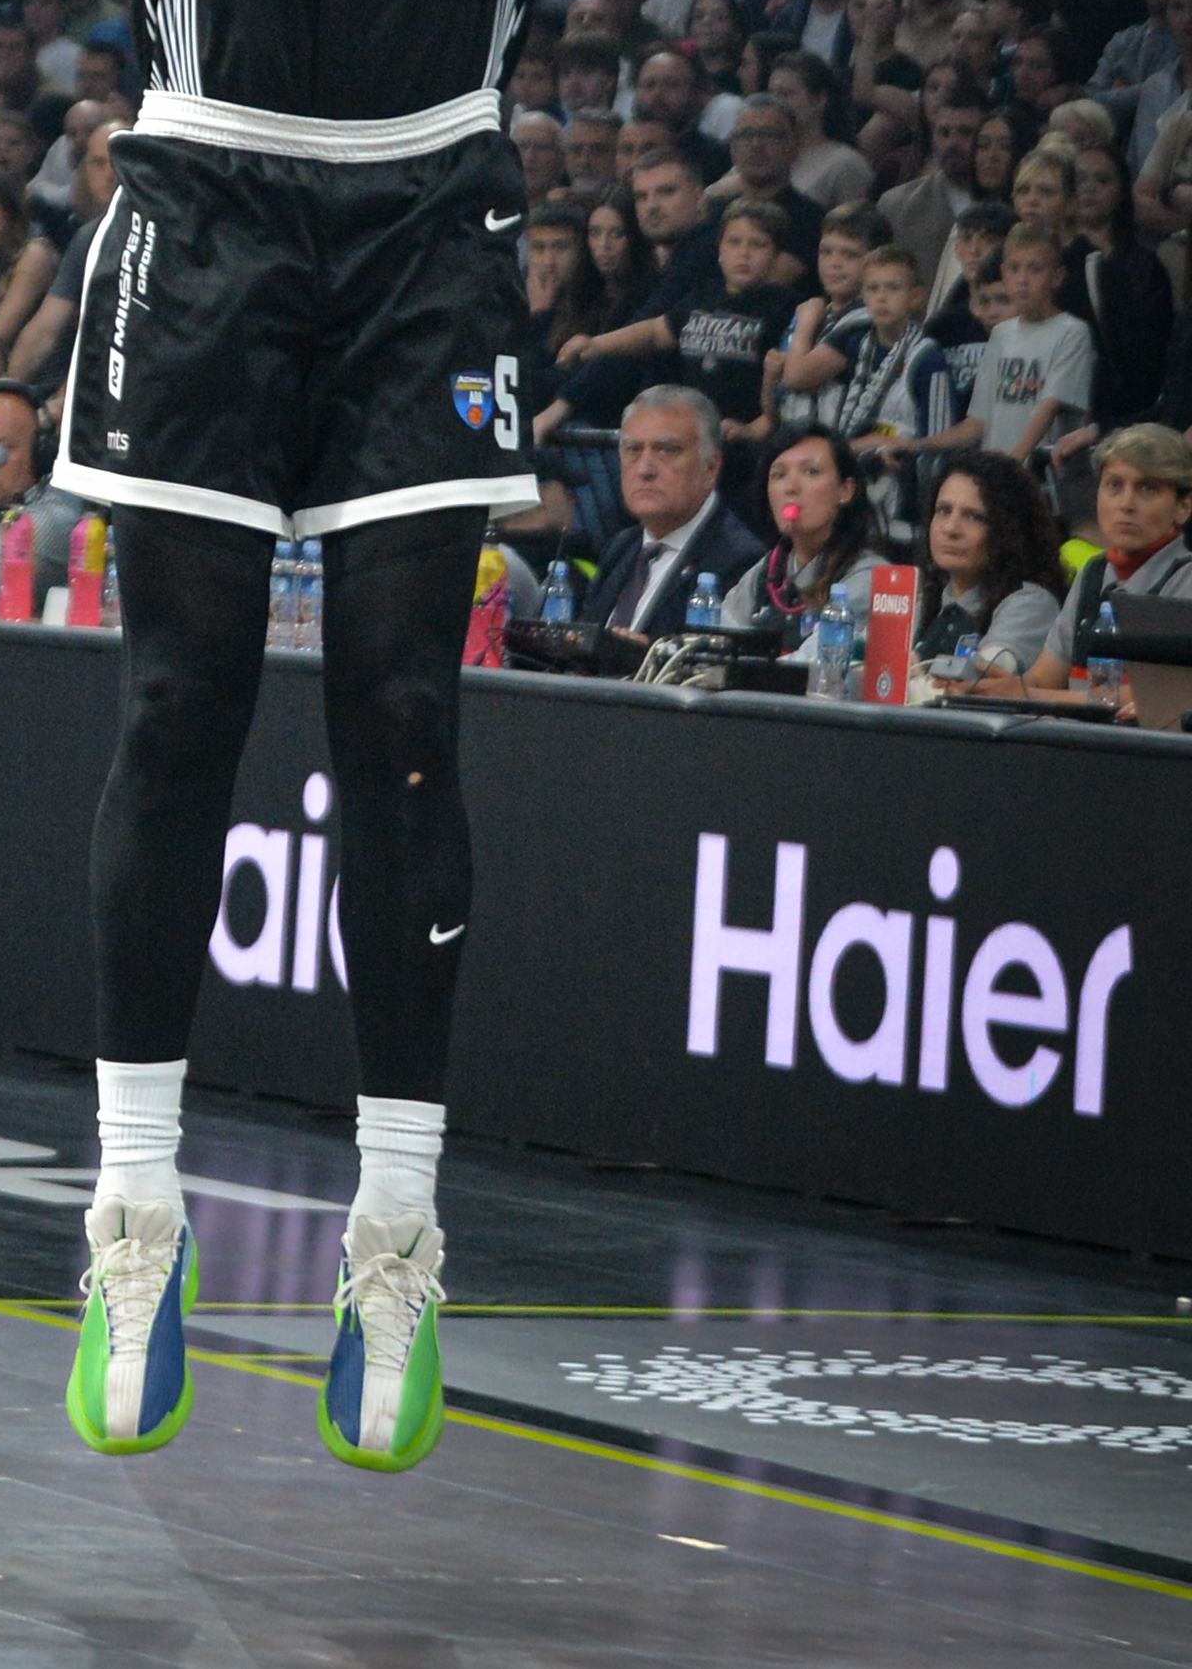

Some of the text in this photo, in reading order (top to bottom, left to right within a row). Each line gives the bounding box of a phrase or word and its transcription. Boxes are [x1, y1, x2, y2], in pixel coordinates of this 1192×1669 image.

[114, 211, 142, 347] MILSPED
[137, 221, 156, 295] GROUP
[494, 355, 519, 450] 5
[872, 593, 909, 614] BONUS
[687, 831, 1134, 1118] Haier
